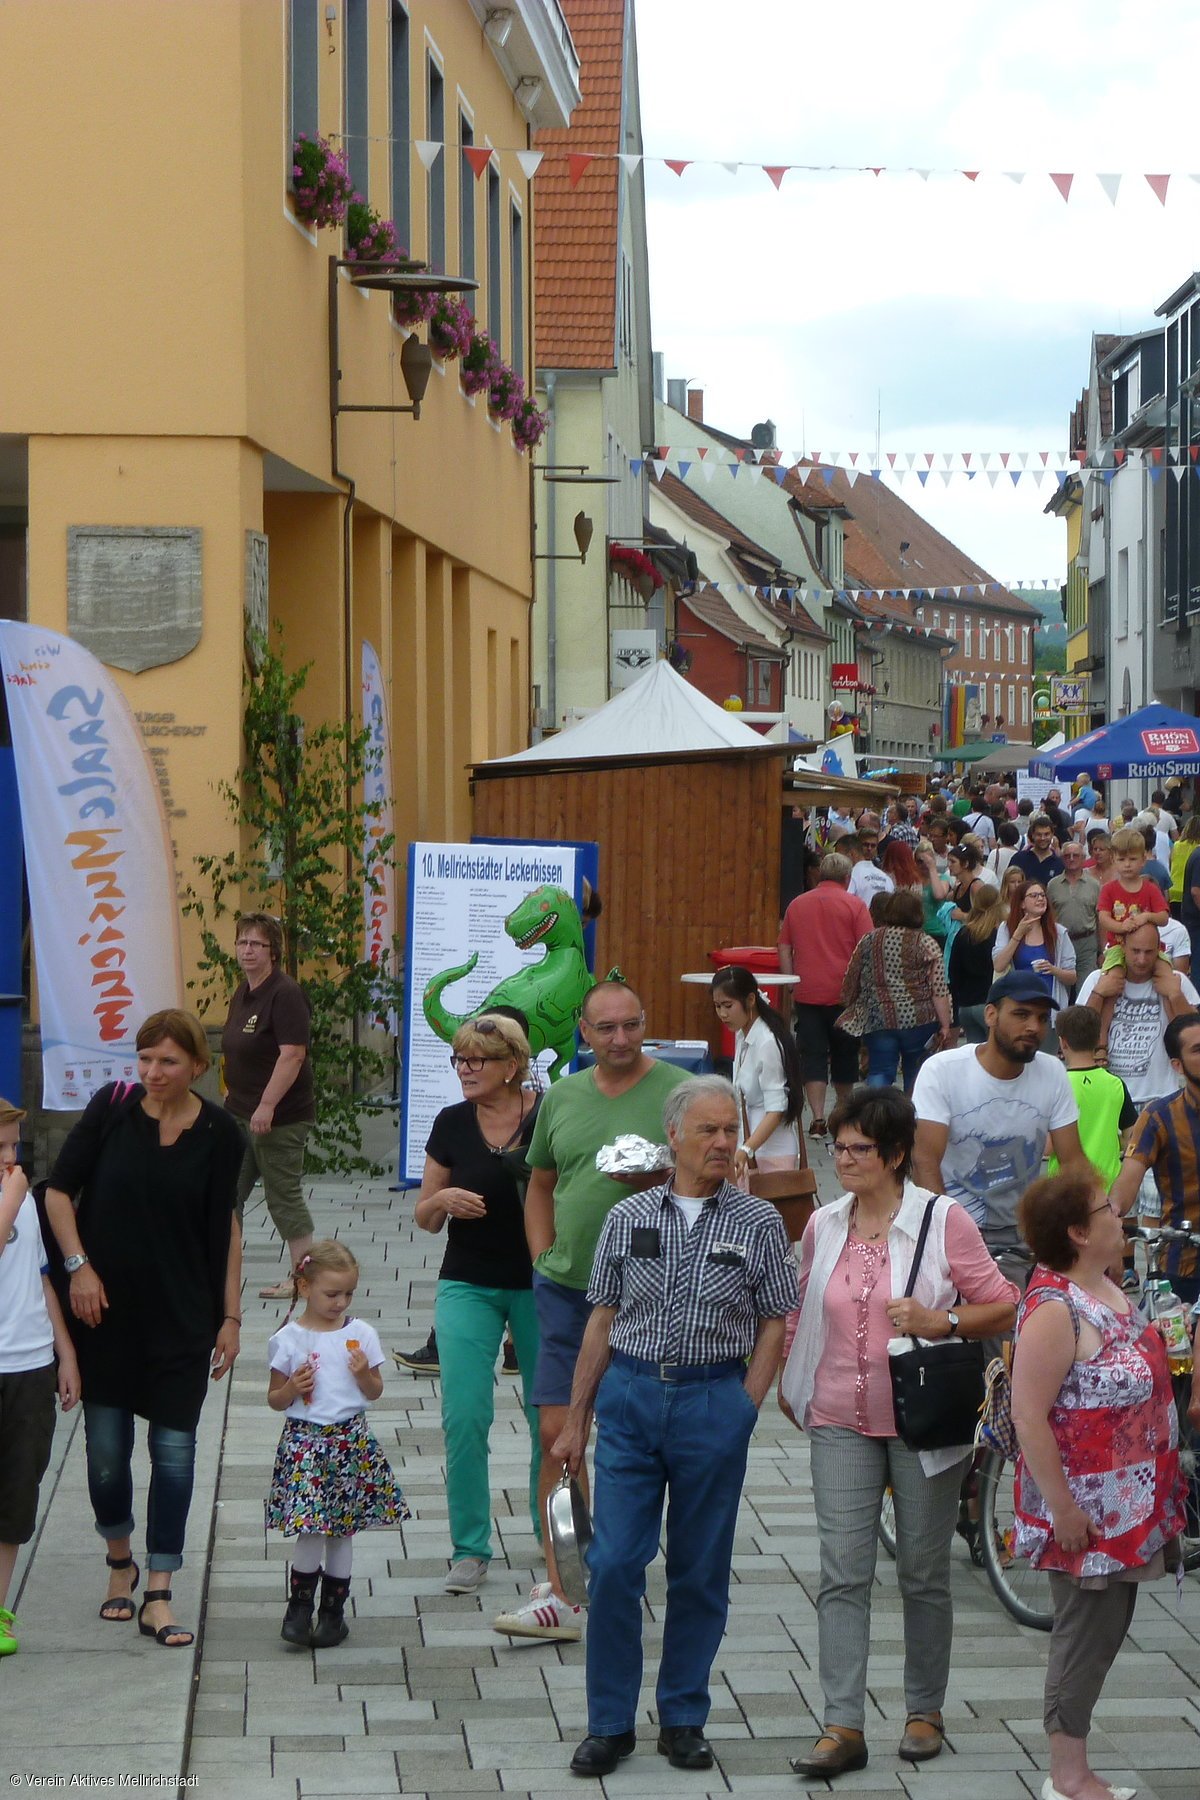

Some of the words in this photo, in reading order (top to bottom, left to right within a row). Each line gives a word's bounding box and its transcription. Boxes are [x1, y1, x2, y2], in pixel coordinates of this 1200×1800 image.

[832, 675, 858, 687] ariston
[1148, 731, 1190, 742] RHÖN
[1150, 739, 1192, 747] SPRUDEL
[423, 853, 435, 879] 10.
[437, 854, 503, 881] Mellrichstädter
[505, 857, 562, 883] Leckerbissen
